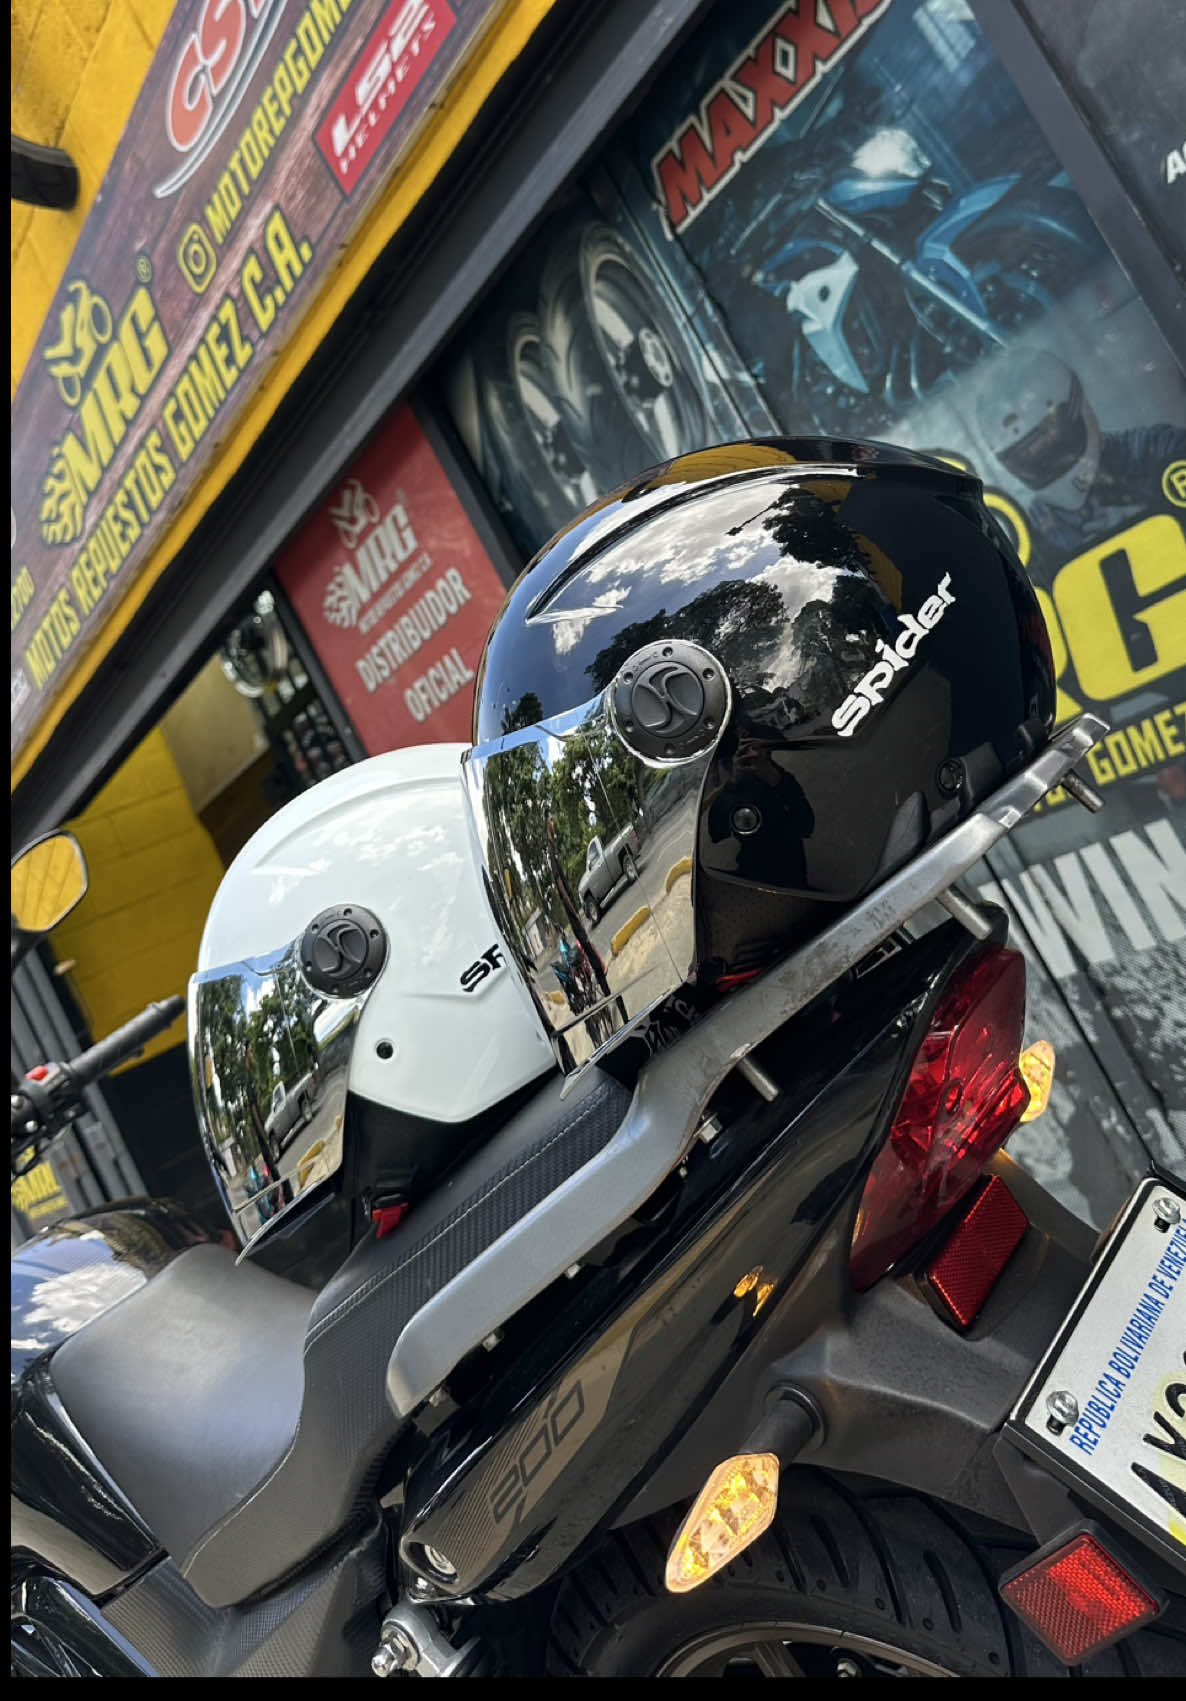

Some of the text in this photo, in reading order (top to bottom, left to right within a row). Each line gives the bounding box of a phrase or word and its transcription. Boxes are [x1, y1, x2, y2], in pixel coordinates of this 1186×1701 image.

[166, 0, 264, 152] CS
[203, 0, 350, 244] MOTOREPGOM
[331, 0, 430, 157] LS2
[654, 0, 888, 233] MAXXI
[25, 210, 314, 689] MOTOS REPUESTOS GOMEZ C.A.
[58, 286, 170, 507] MRG
[338, 503, 419, 614] MRG
[355, 566, 472, 693] DISTRIBUIDOR
[403, 647, 475, 724] OFICIAL
[1069, 1372, 1126, 1456] REPUBLICA
[1108, 1293, 1166, 1380] BOLIVARIANA
[1148, 1274, 1174, 1299] DE
[492, 1379, 585, 1526] 200
